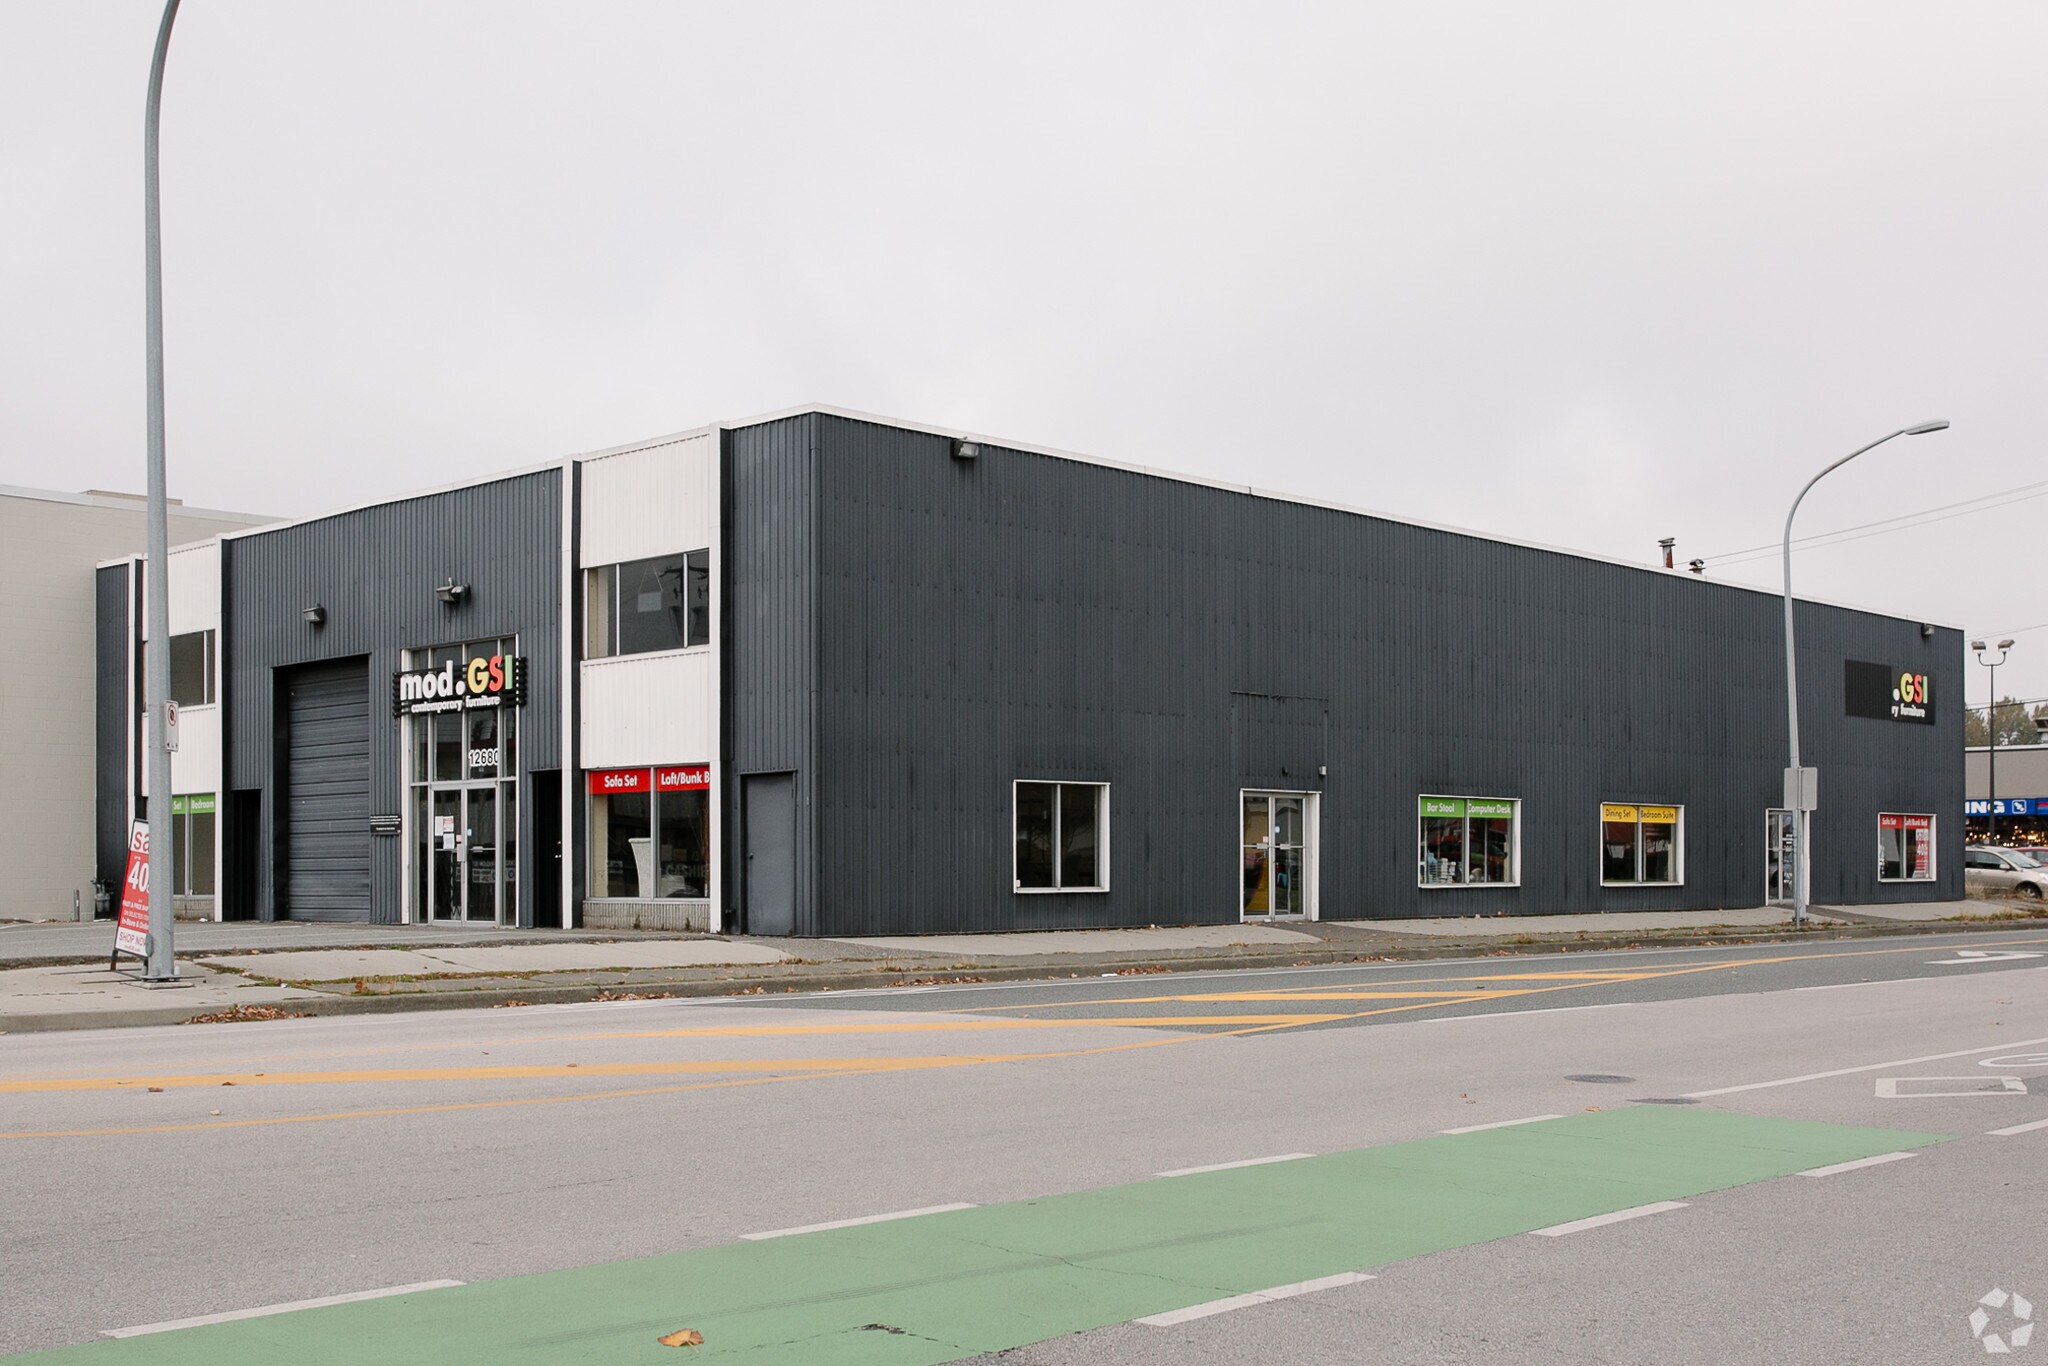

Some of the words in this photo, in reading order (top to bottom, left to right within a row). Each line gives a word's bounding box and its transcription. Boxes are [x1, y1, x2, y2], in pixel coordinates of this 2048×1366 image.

[411, 700, 463, 713] contemporary
[465, 695, 501, 708] furniture
[1900, 703, 1926, 718] furniture
[604, 775, 622, 788] Sofa
[624, 775, 638, 787] Set
[661, 771, 702, 786] Loft/Bunk
[173, 800, 182, 810] Set
[192, 799, 215, 809] Bedroom
[1426, 802, 1438, 813] Bar
[1439, 803, 1455, 813] Stool
[1468, 804, 1496, 815] Computer
[1497, 804, 1511, 814] Desk
[1605, 808, 1622, 819] Dining
[1623, 809, 1631, 818] Set
[1640, 810, 1662, 819] Bedroom
[1663, 810, 1674, 819] Suite
[128, 860, 149, 894] 40
[119, 931, 135, 943] SHOP
